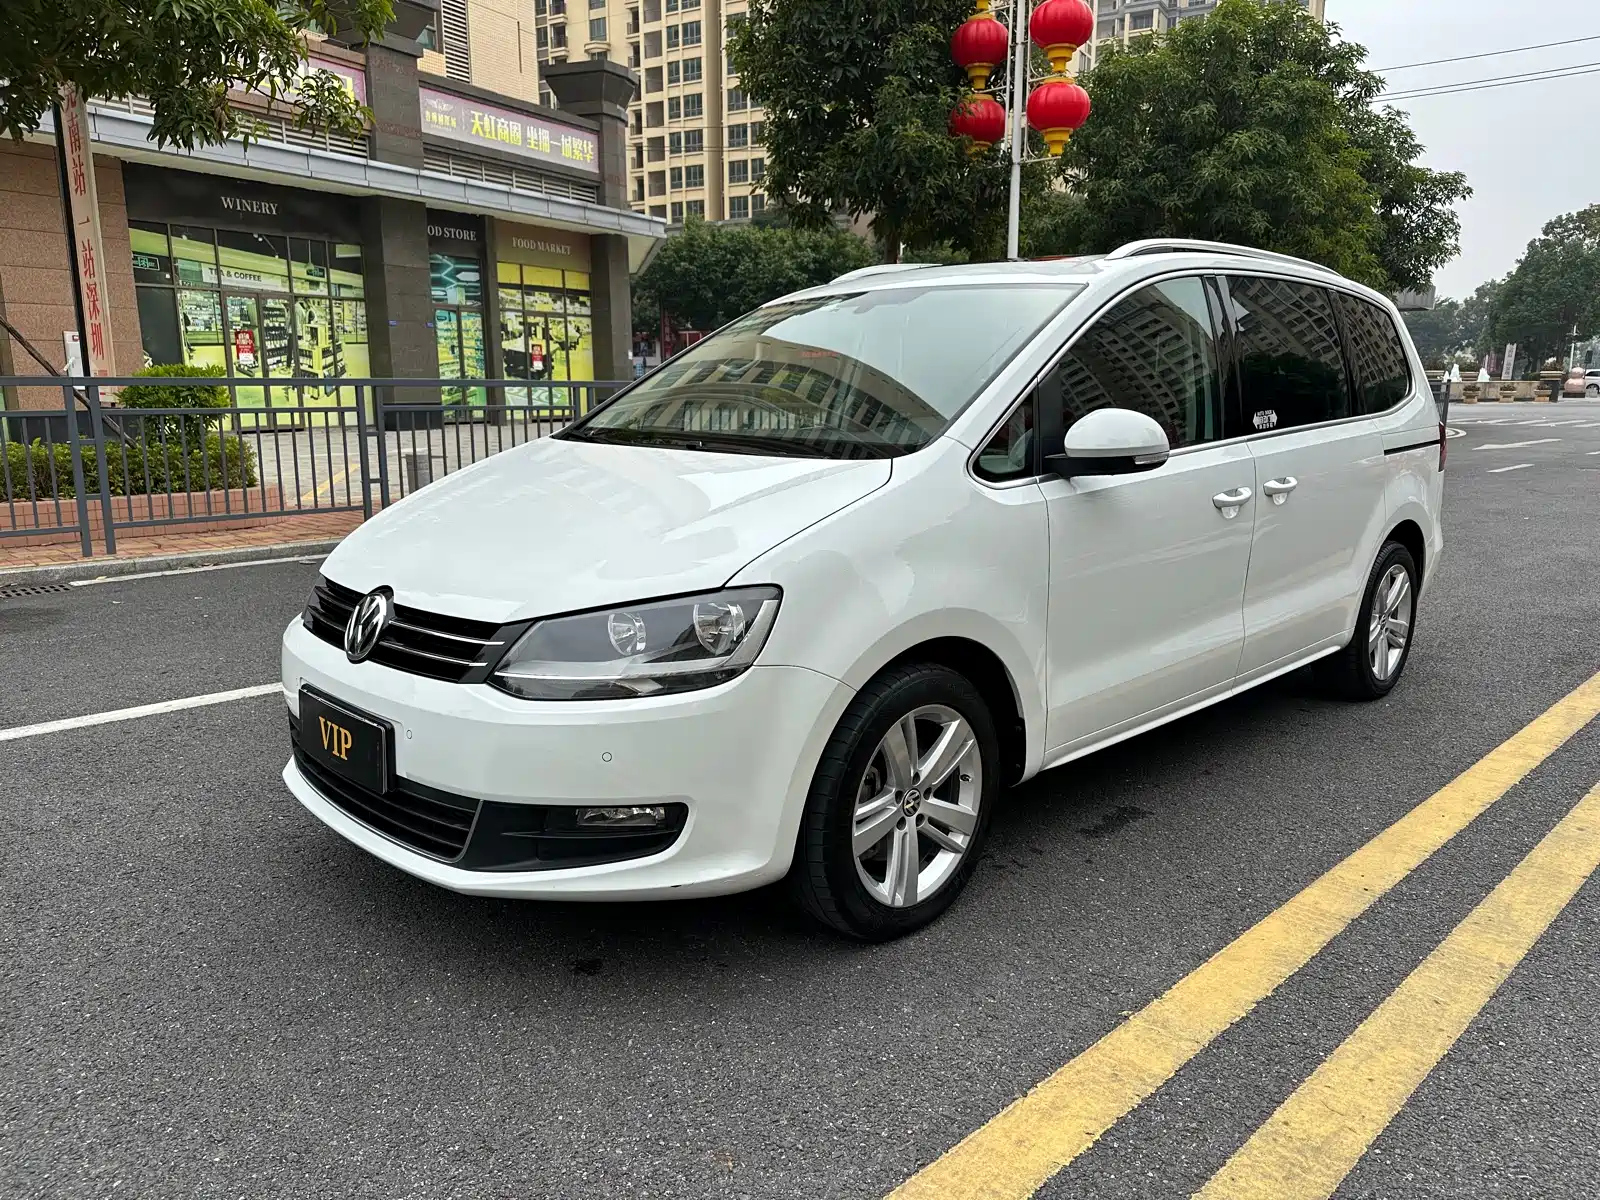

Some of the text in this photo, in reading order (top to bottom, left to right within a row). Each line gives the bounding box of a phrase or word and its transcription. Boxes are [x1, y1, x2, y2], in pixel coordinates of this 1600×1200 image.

[470, 110, 522, 147] 天虹商圈
[220, 195, 279, 216] WINERY
[443, 226, 476, 241] STORE
[512, 236, 572, 256] FOOD MARKET
[226, 270, 232, 278] &
[234, 271, 262, 282] COFFEE
[318, 715, 353, 761] VIP
